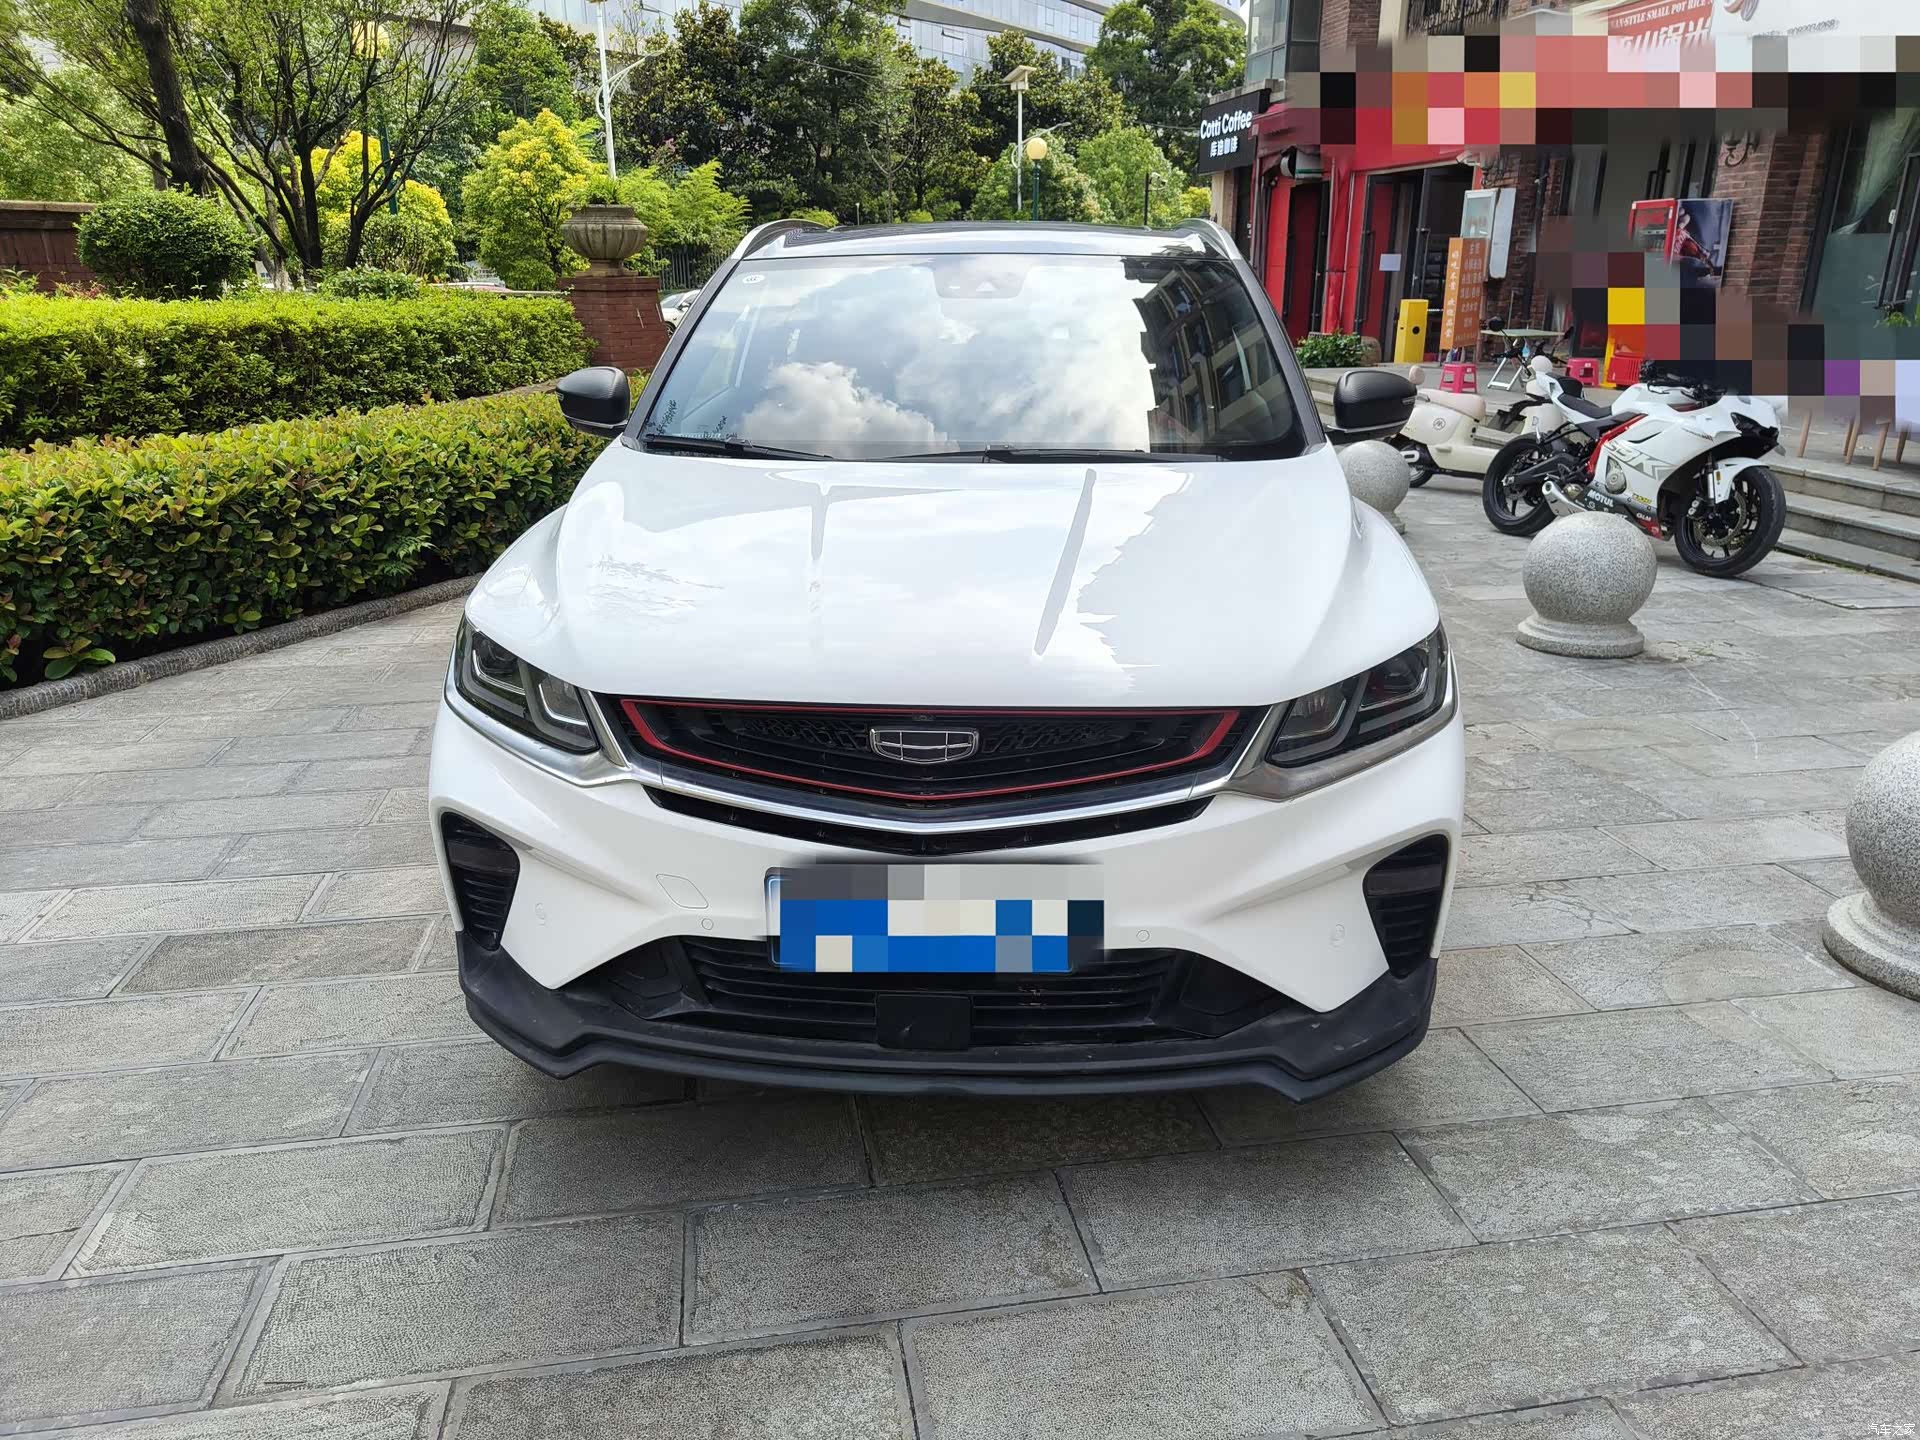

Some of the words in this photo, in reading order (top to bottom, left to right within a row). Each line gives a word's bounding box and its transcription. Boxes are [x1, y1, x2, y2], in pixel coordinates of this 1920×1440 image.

[1647, 6, 1671, 21] SMALL
[1671, 1, 1687, 15] POT
[1200, 116, 1221, 139] Cotti
[1222, 110, 1253, 134] Coffee
[1587, 489, 1614, 507] MOTUL
